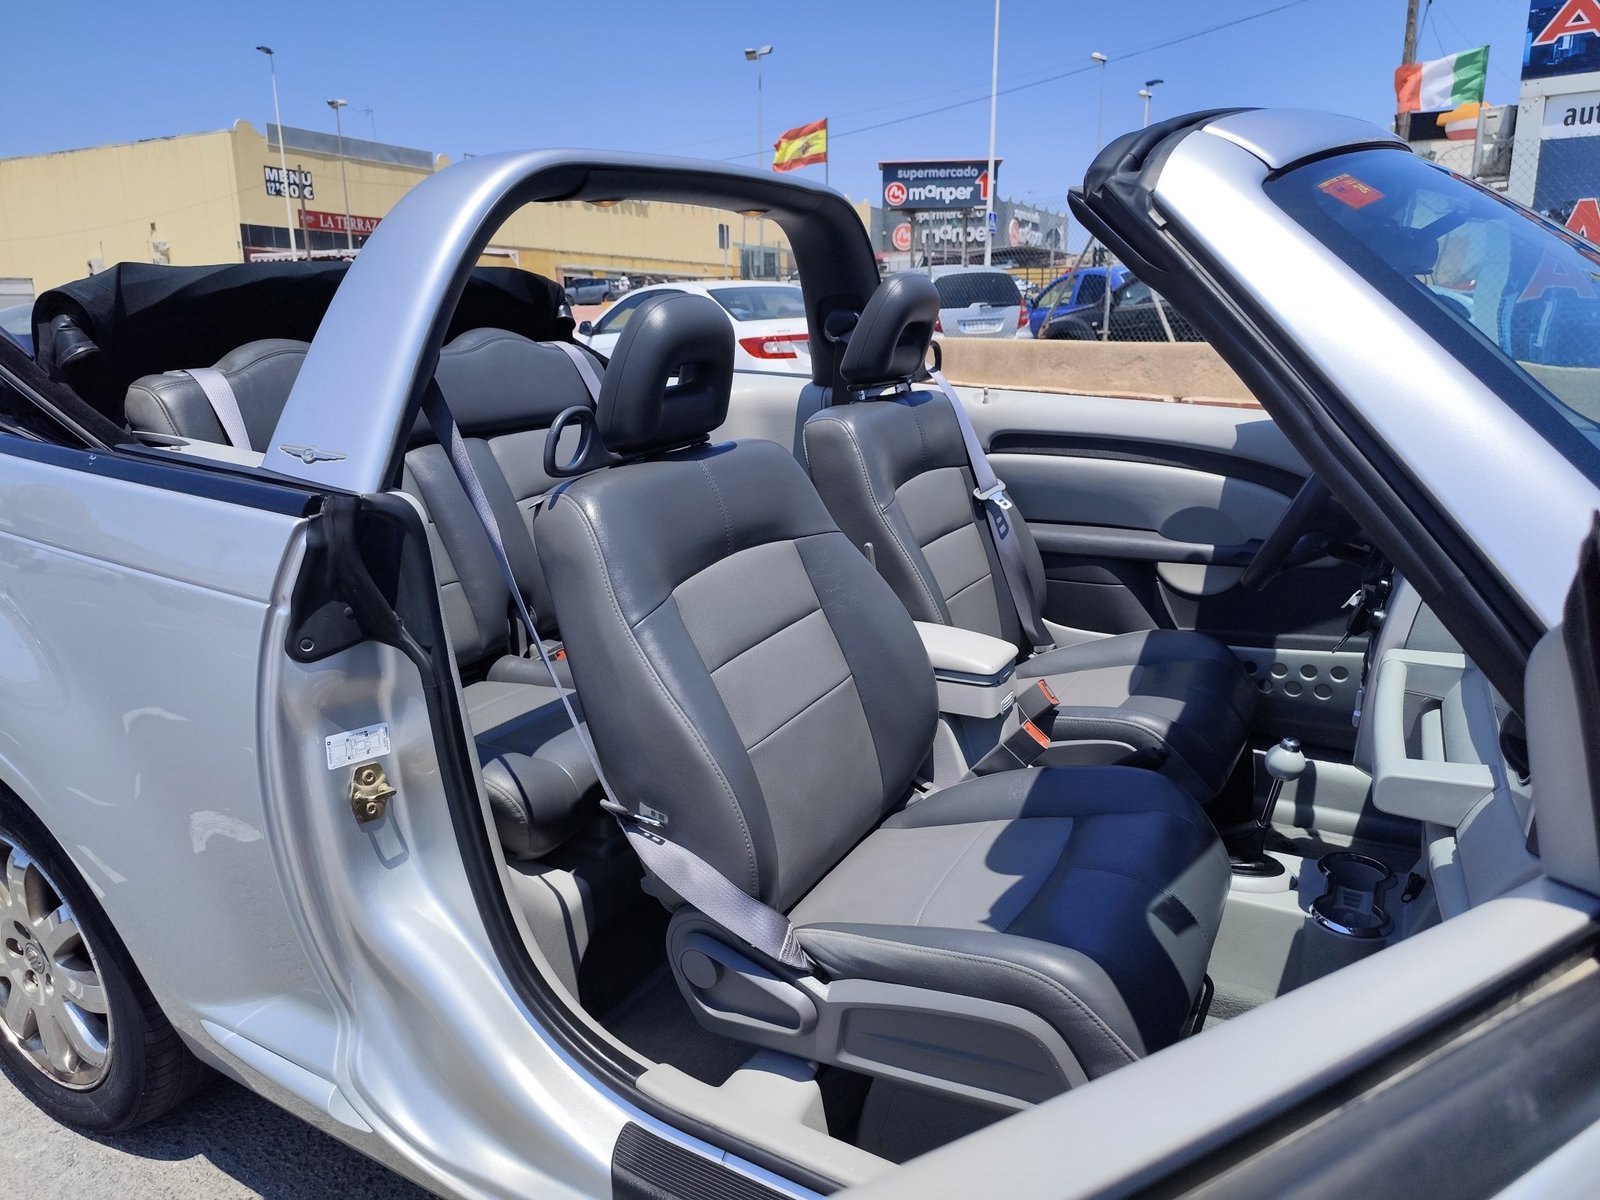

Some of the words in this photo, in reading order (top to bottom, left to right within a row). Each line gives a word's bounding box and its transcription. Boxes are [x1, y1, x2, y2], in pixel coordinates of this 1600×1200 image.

[897, 165, 979, 181] supermercado
[908, 184, 974, 204] manper
[319, 213, 334, 228] LA
